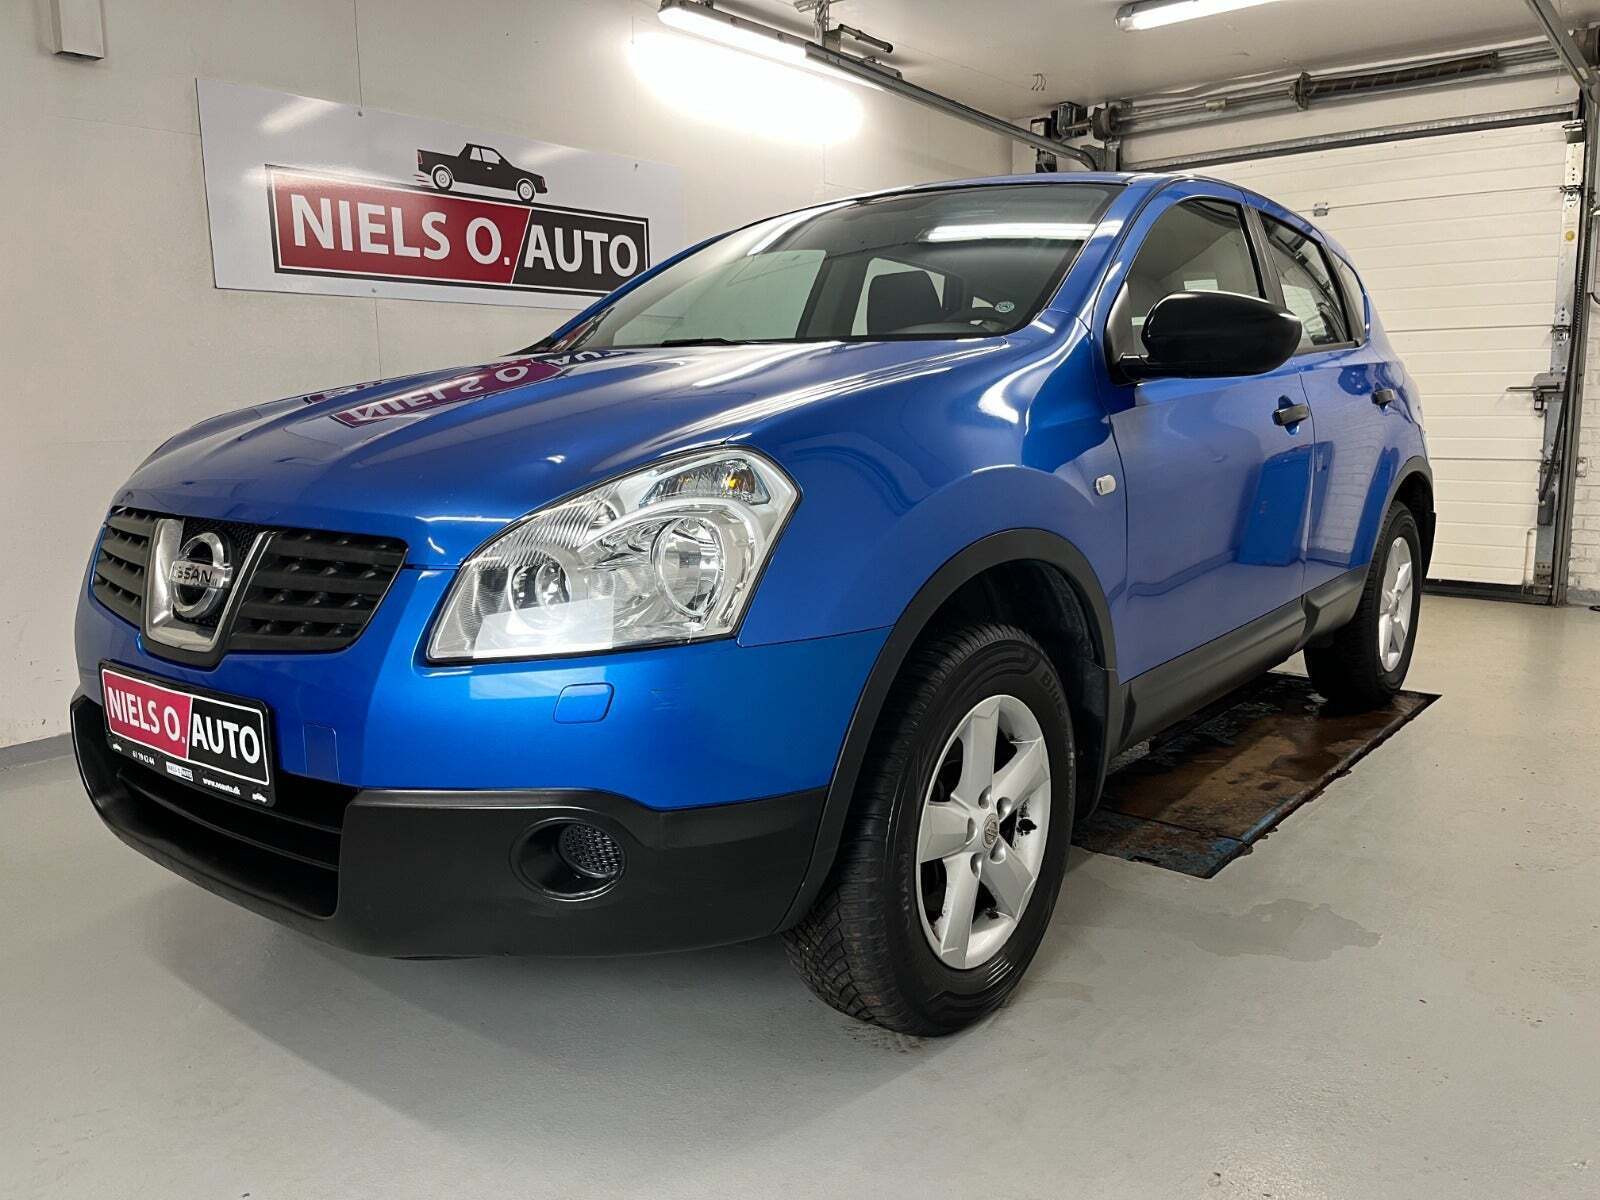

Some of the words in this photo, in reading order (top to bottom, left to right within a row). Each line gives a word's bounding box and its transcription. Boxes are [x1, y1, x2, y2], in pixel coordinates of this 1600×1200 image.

[290, 194, 450, 262] NIELS
[465, 217, 510, 266] O.
[523, 224, 639, 278] AUTO
[107, 687, 161, 734] NIELS
[163, 706, 186, 744] O.
[191, 713, 261, 764] AUTO
